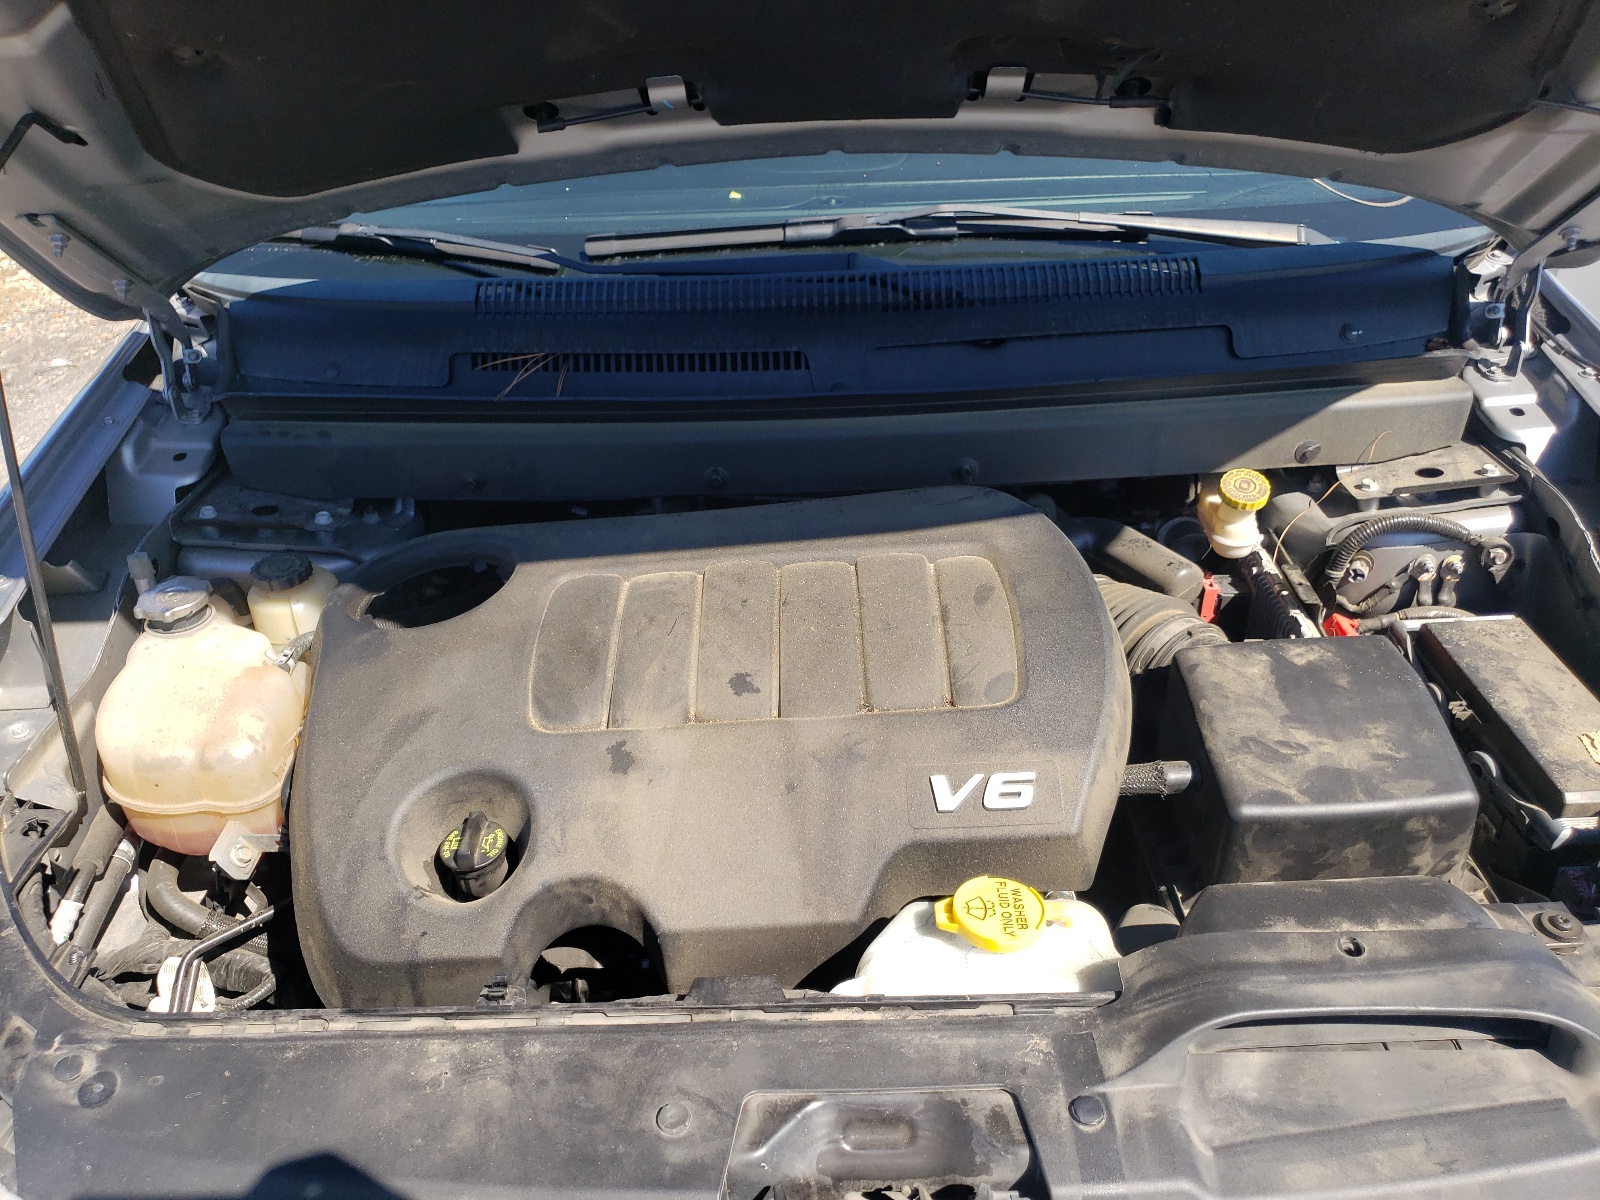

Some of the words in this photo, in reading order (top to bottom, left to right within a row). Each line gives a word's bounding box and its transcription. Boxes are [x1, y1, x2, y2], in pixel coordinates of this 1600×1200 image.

[929, 772, 1036, 813] V6
[495, 828, 504, 849] ENGINE
[486, 848, 499, 857] OIL
[995, 881, 1010, 909] FLUID
[1010, 887, 1029, 931] WASHER
[1000, 910, 1016, 937] ONLY
